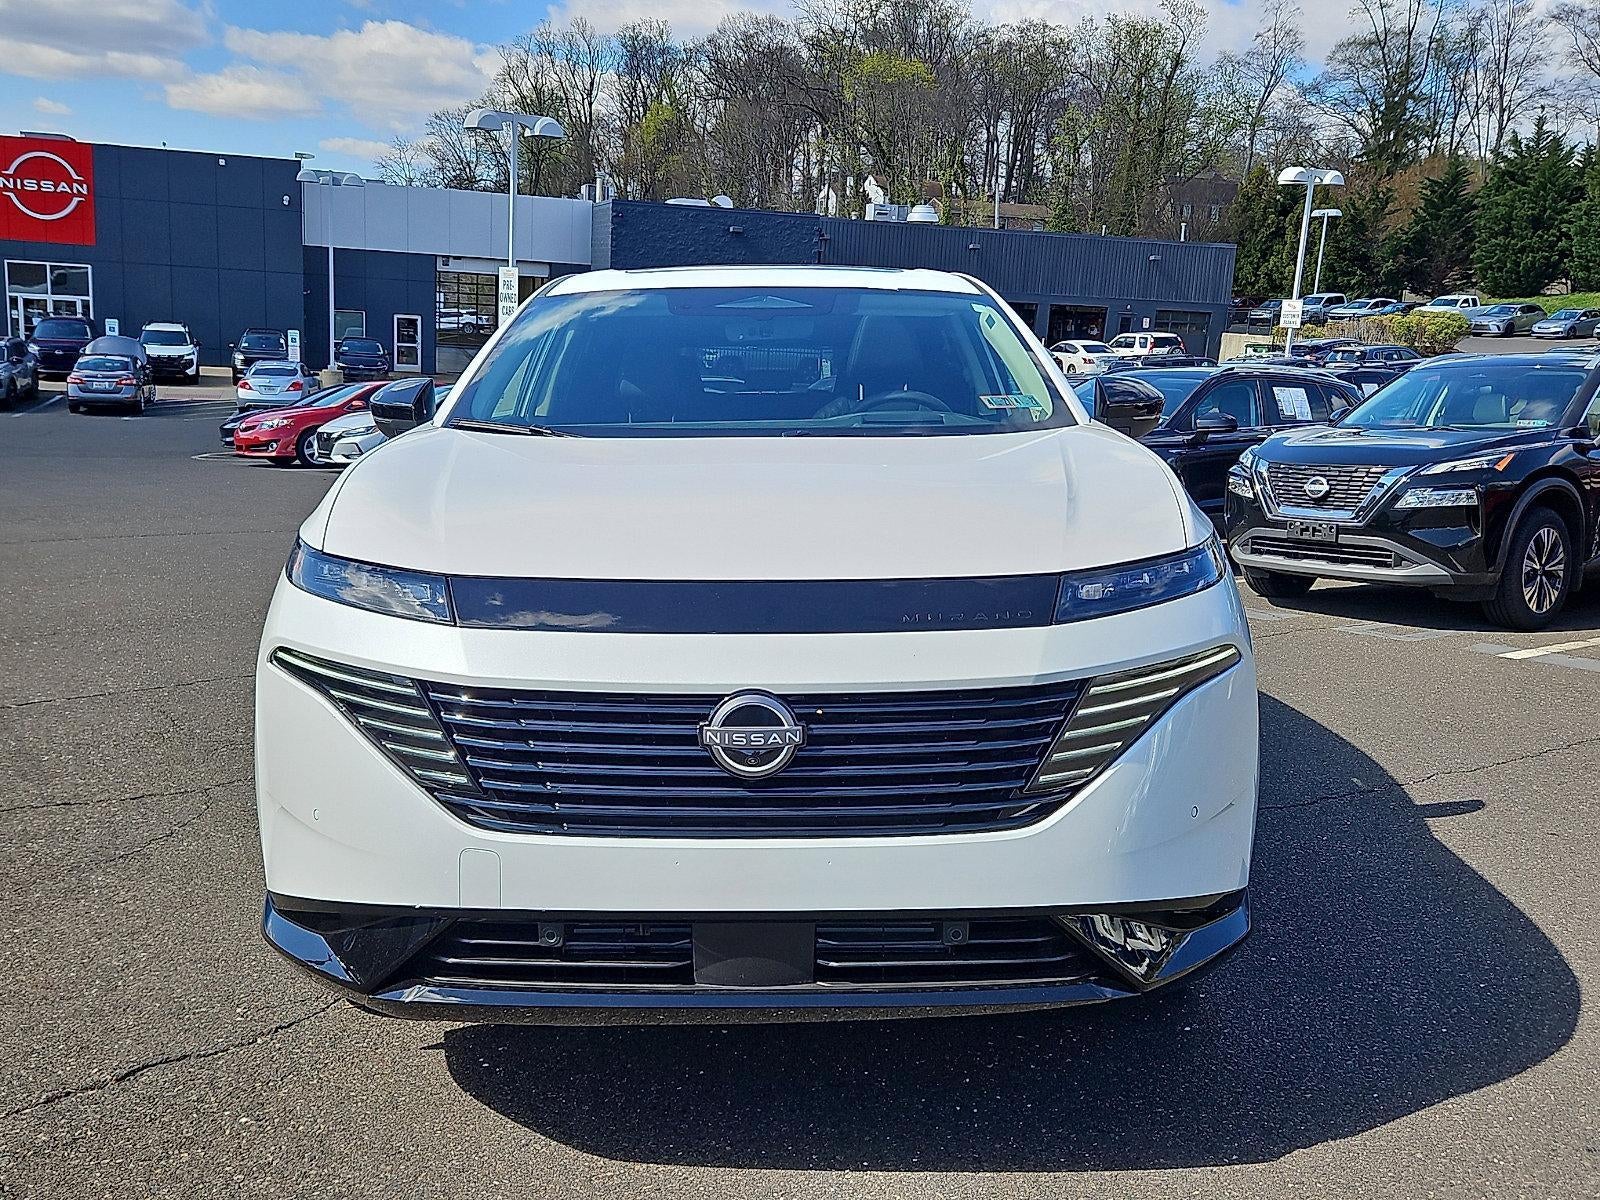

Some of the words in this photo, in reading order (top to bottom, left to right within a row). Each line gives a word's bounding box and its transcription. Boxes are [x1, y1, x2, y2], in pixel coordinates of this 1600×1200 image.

[0, 177, 88, 195] NISSAN
[502, 279, 515, 291] PRE-
[499, 292, 517, 304] OWNED
[501, 305, 515, 317] CARS
[902, 609, 1033, 622] MURANO
[706, 730, 800, 746] NISSAN
